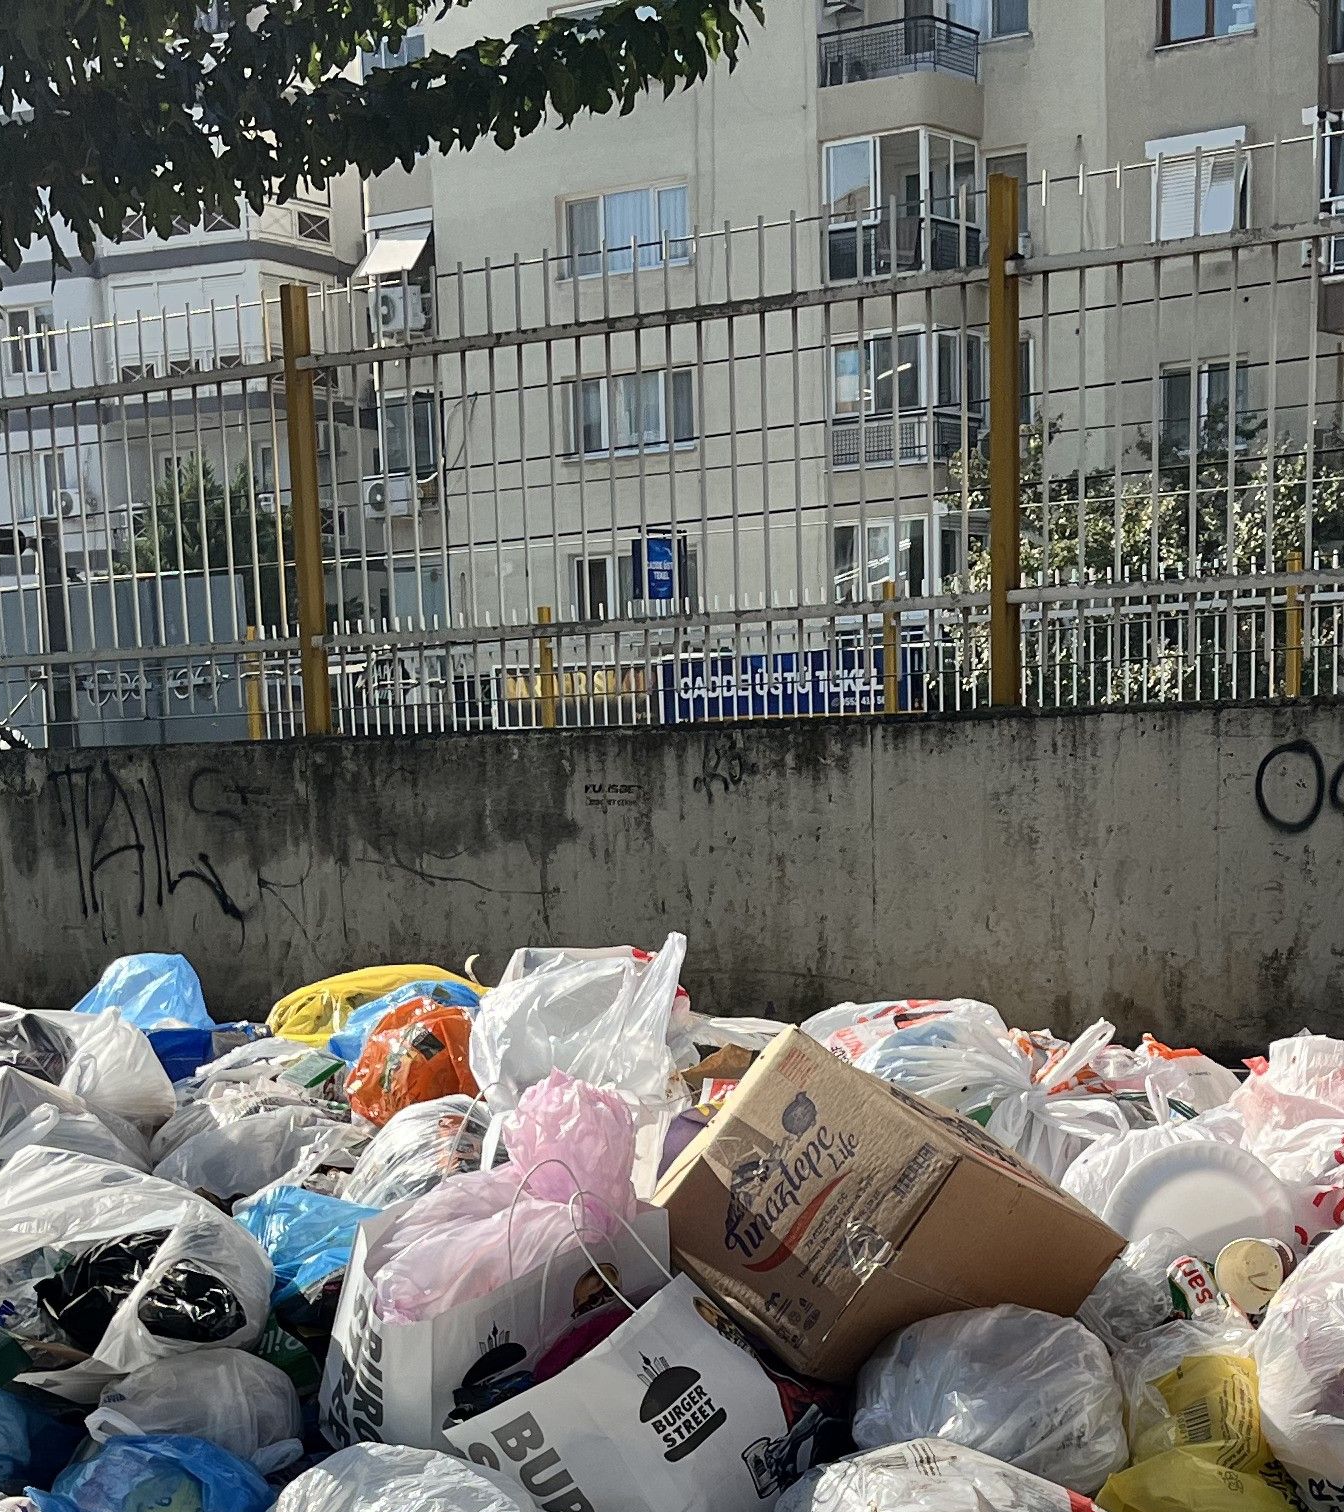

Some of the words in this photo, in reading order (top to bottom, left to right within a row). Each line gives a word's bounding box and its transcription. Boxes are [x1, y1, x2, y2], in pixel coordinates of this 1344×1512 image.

[681, 675, 749, 699] CADDE
[756, 668, 809, 696] ÜSTÜ
[816, 667, 884, 693] TEKEL
[651, 1384, 709, 1435] BURGER
[661, 1398, 717, 1450] STREET
